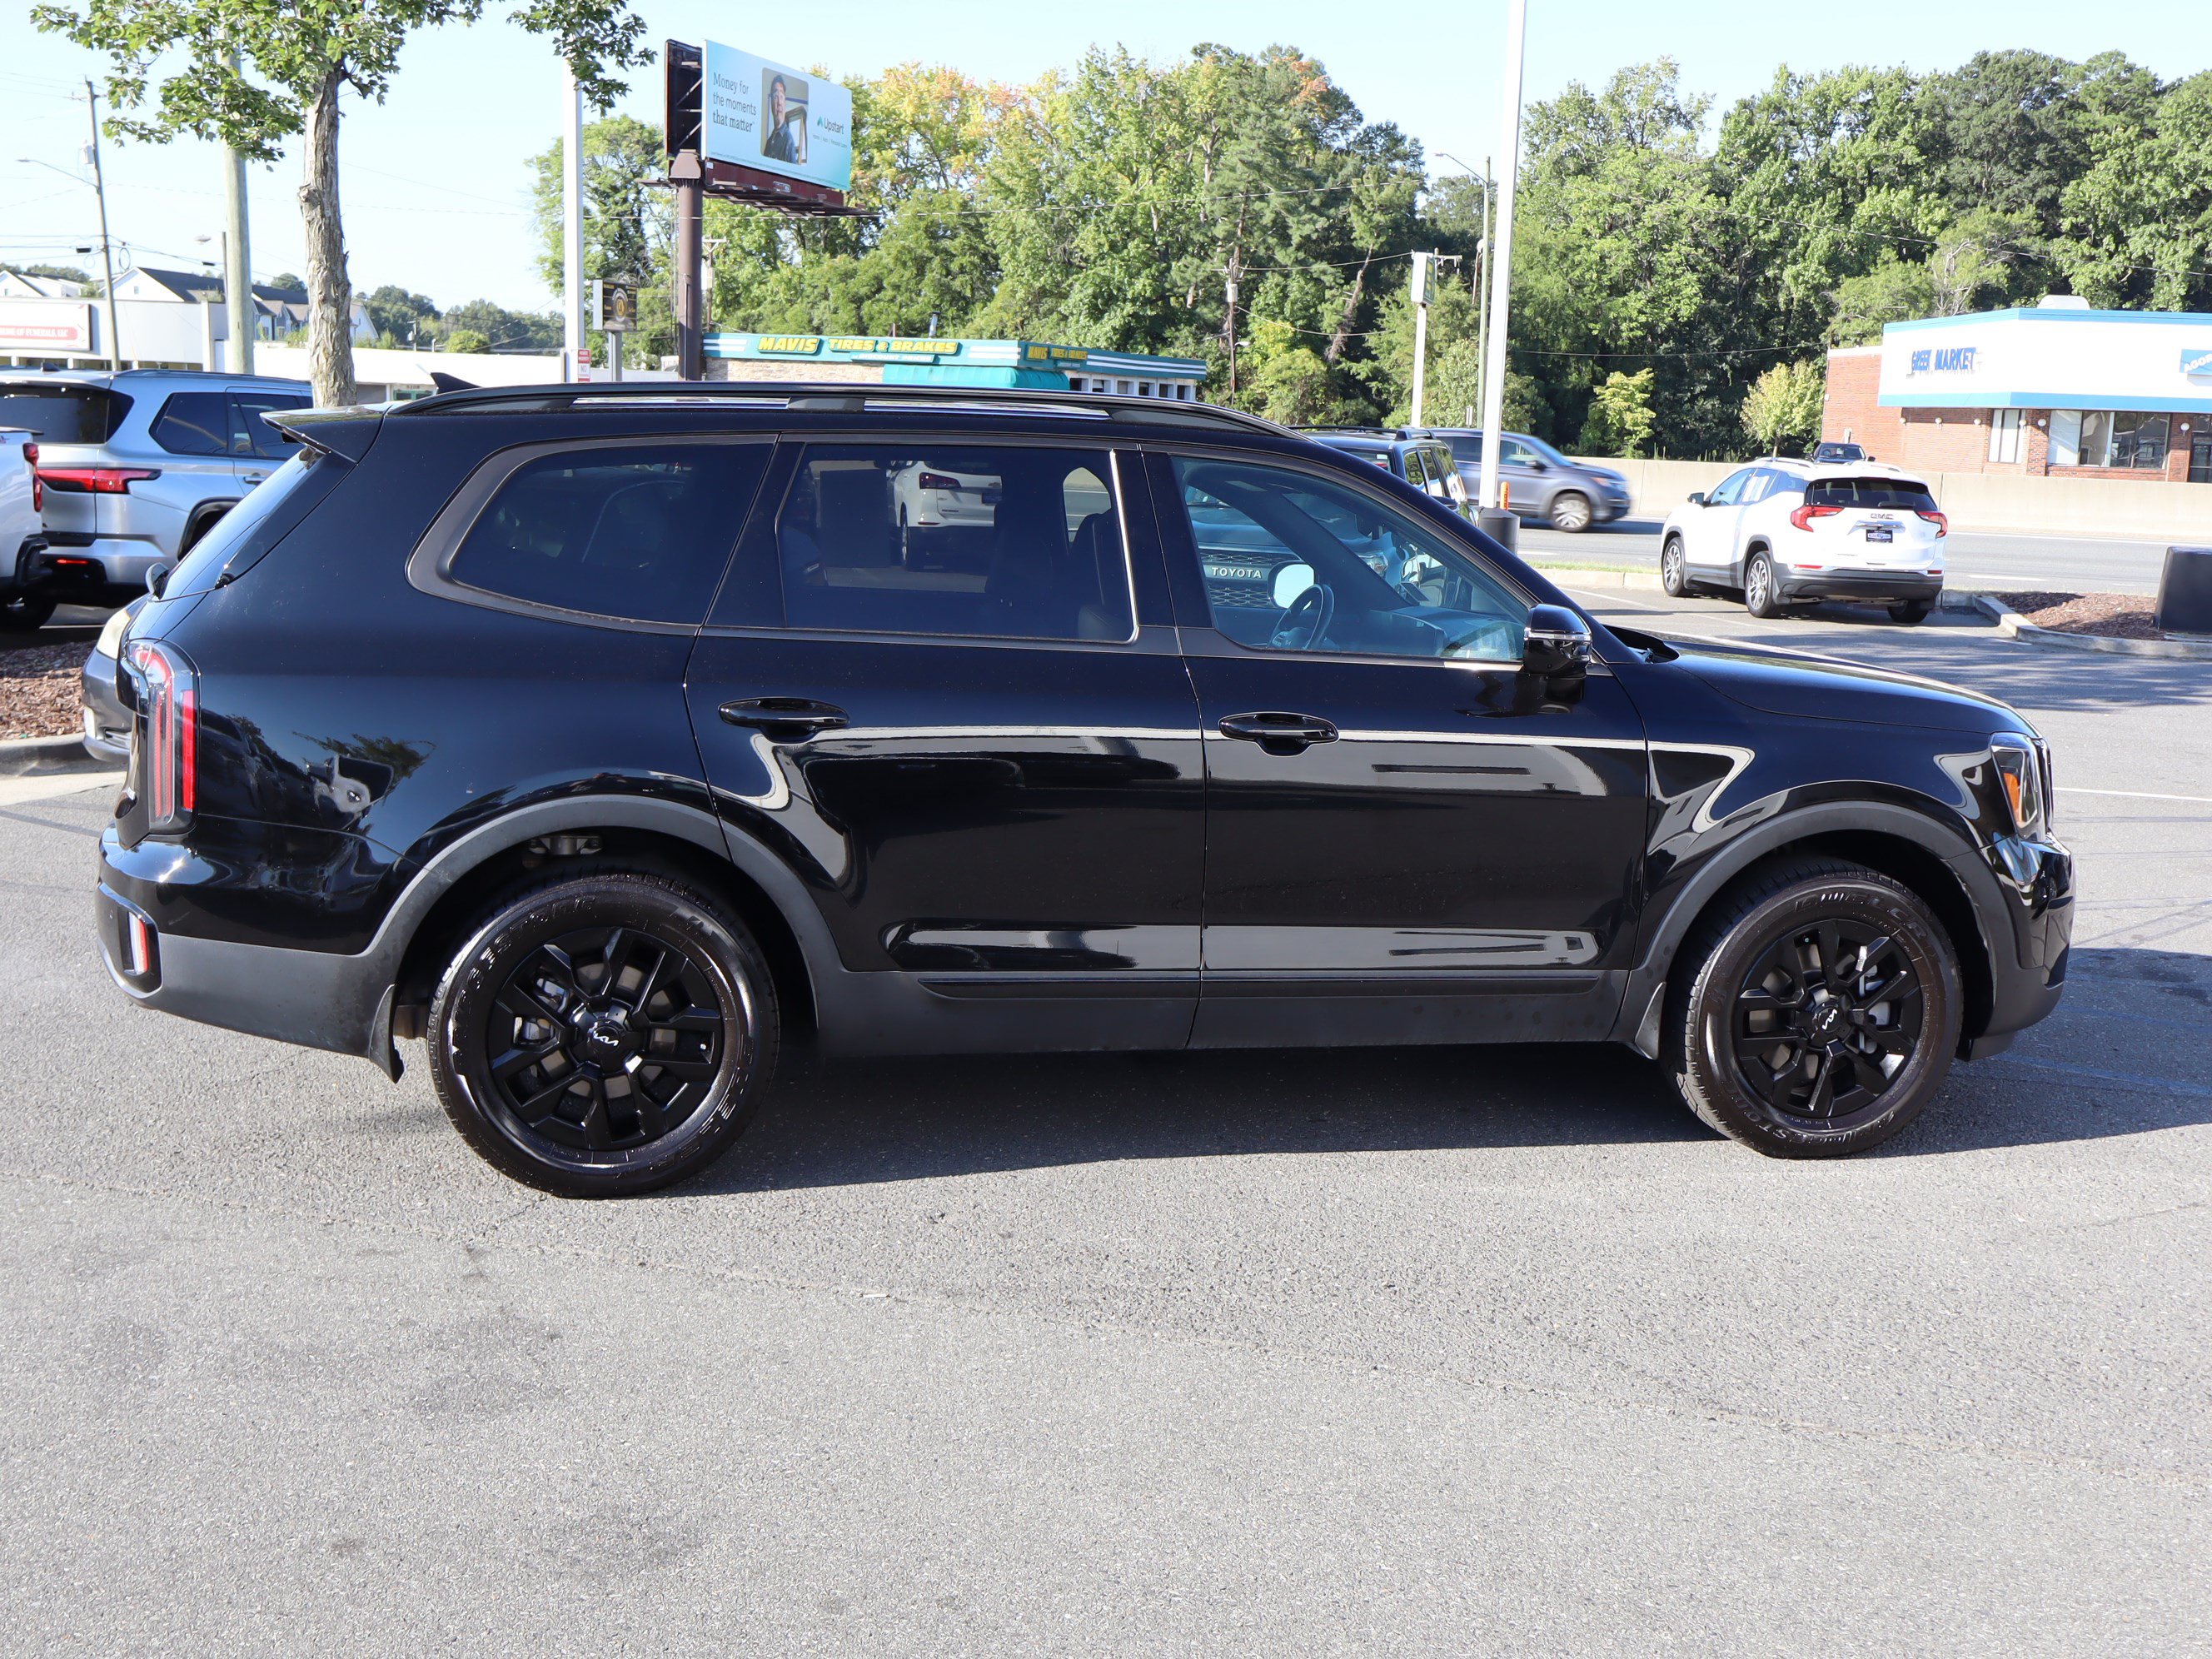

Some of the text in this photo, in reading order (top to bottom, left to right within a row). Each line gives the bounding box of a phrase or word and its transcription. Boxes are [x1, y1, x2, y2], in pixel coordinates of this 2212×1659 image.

[714, 72, 749, 95] Money for
[713, 92, 757, 117] the moments
[713, 109, 753, 133] that matter
[825, 117, 844, 135] Upstart
[758, 336, 958, 353] MAVIS TIRES & BRAKES
[1935, 346, 1977, 371] MARKET
[1212, 567, 1263, 579] TOYOTA
